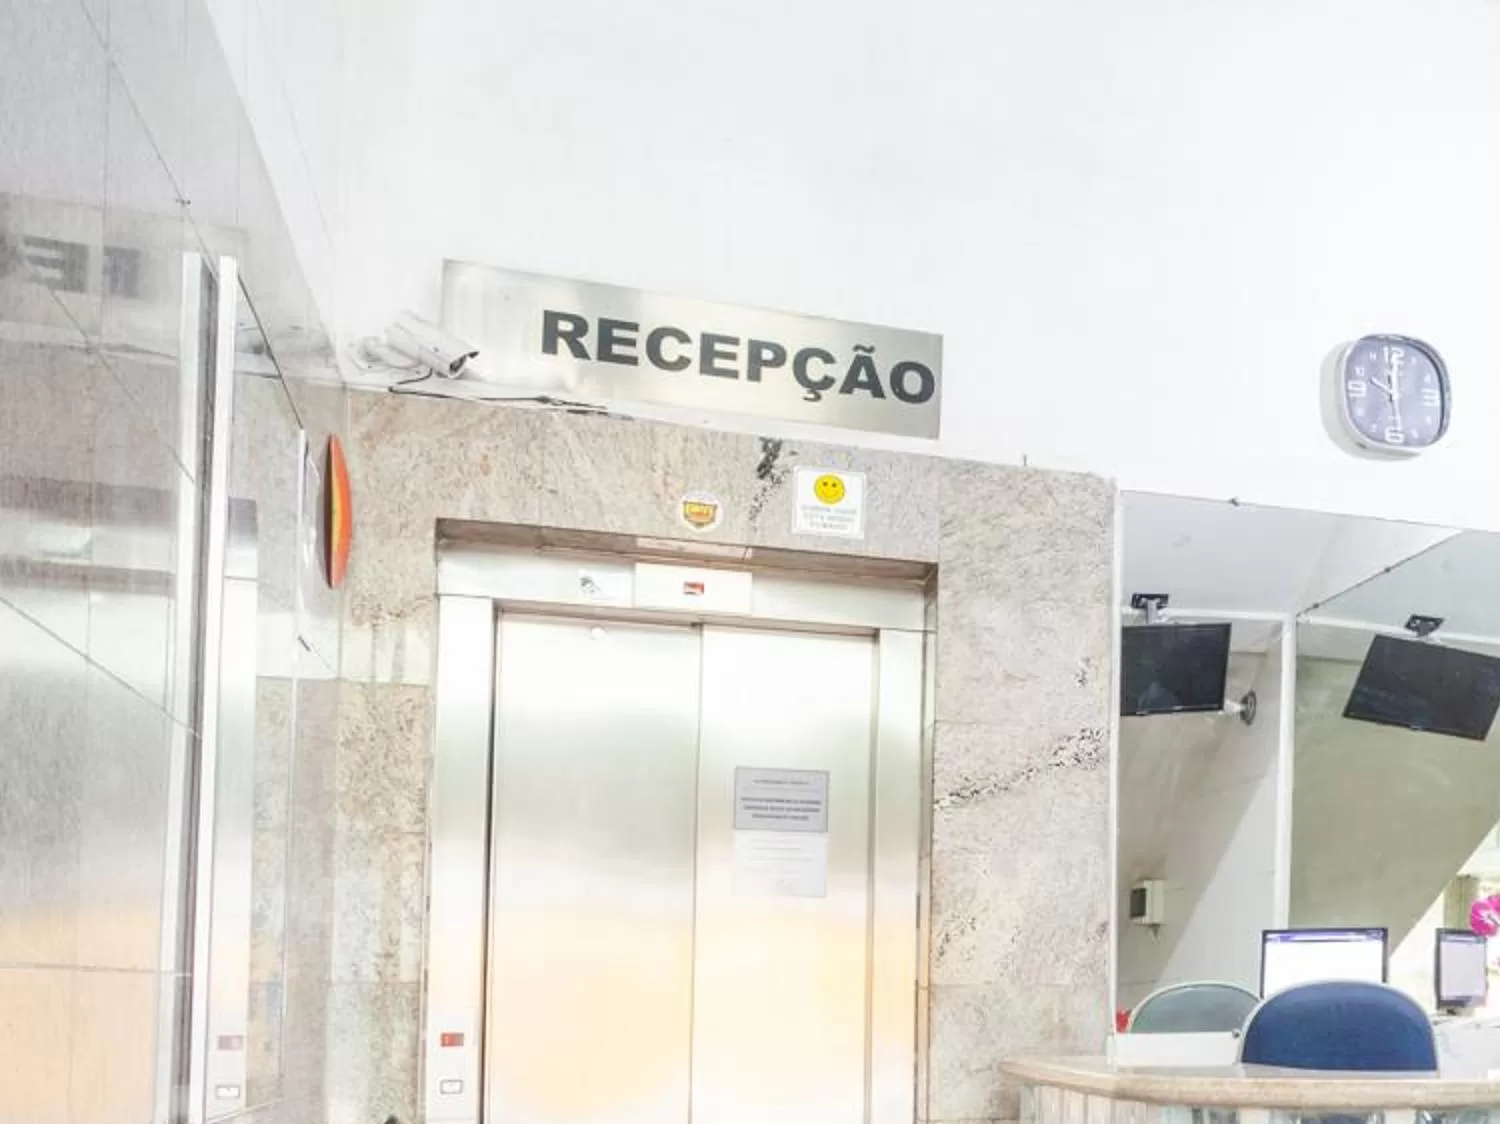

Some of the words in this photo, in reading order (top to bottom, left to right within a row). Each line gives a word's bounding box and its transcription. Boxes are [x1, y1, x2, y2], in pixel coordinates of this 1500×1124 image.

[541, 308, 936, 402] RECEPÇÃO
[1347, 379, 1367, 398] 9
[1384, 427, 1405, 444] 6
